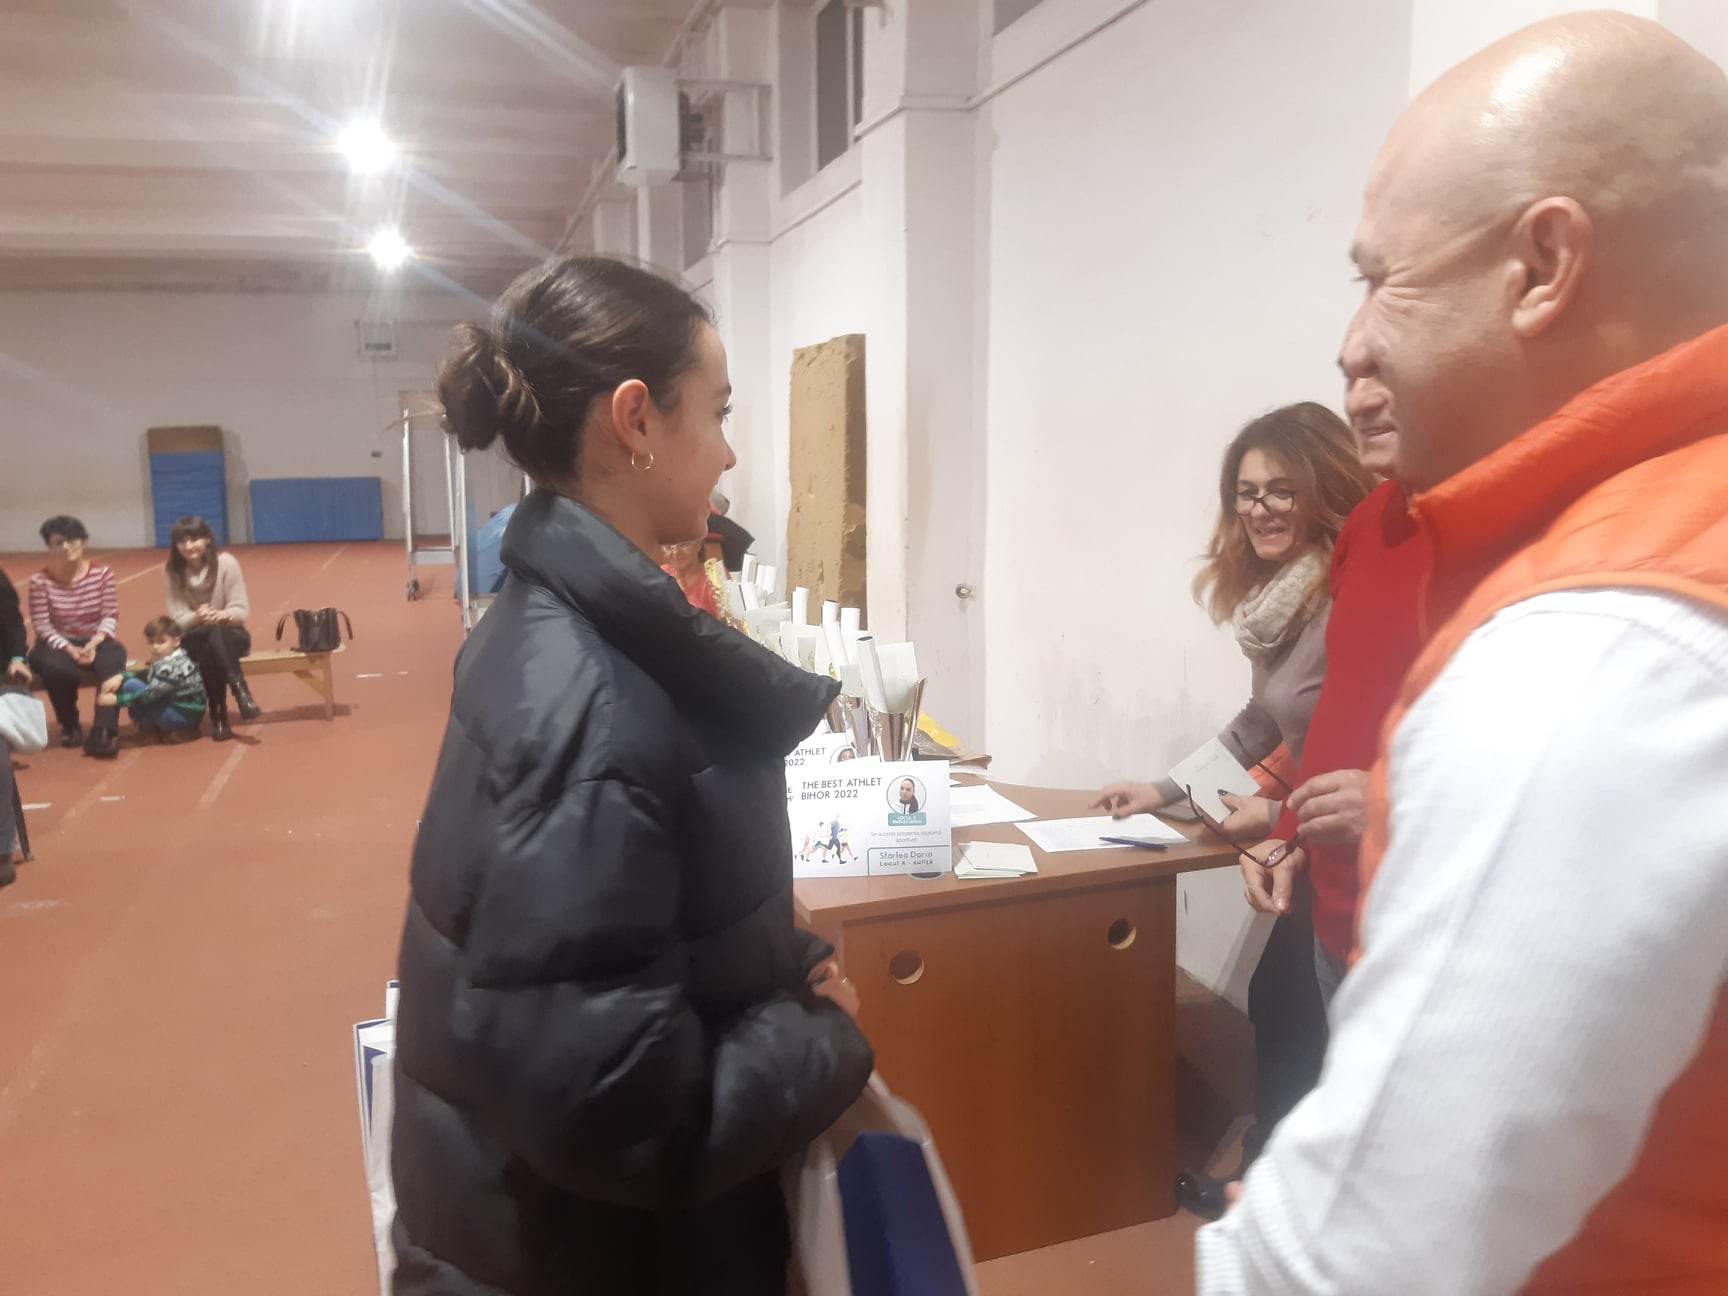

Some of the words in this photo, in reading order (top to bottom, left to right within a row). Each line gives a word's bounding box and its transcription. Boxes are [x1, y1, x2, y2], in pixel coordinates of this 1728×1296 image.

[794, 747, 826, 757] ATHLET
[784, 758, 805, 767] 2022
[802, 781, 819, 790] THE
[821, 779, 843, 789] BEST
[846, 777, 882, 787] ATHLET
[801, 791, 830, 801] BIHOR
[834, 789, 858, 799] 2022
[910, 850, 933, 859] Daria
